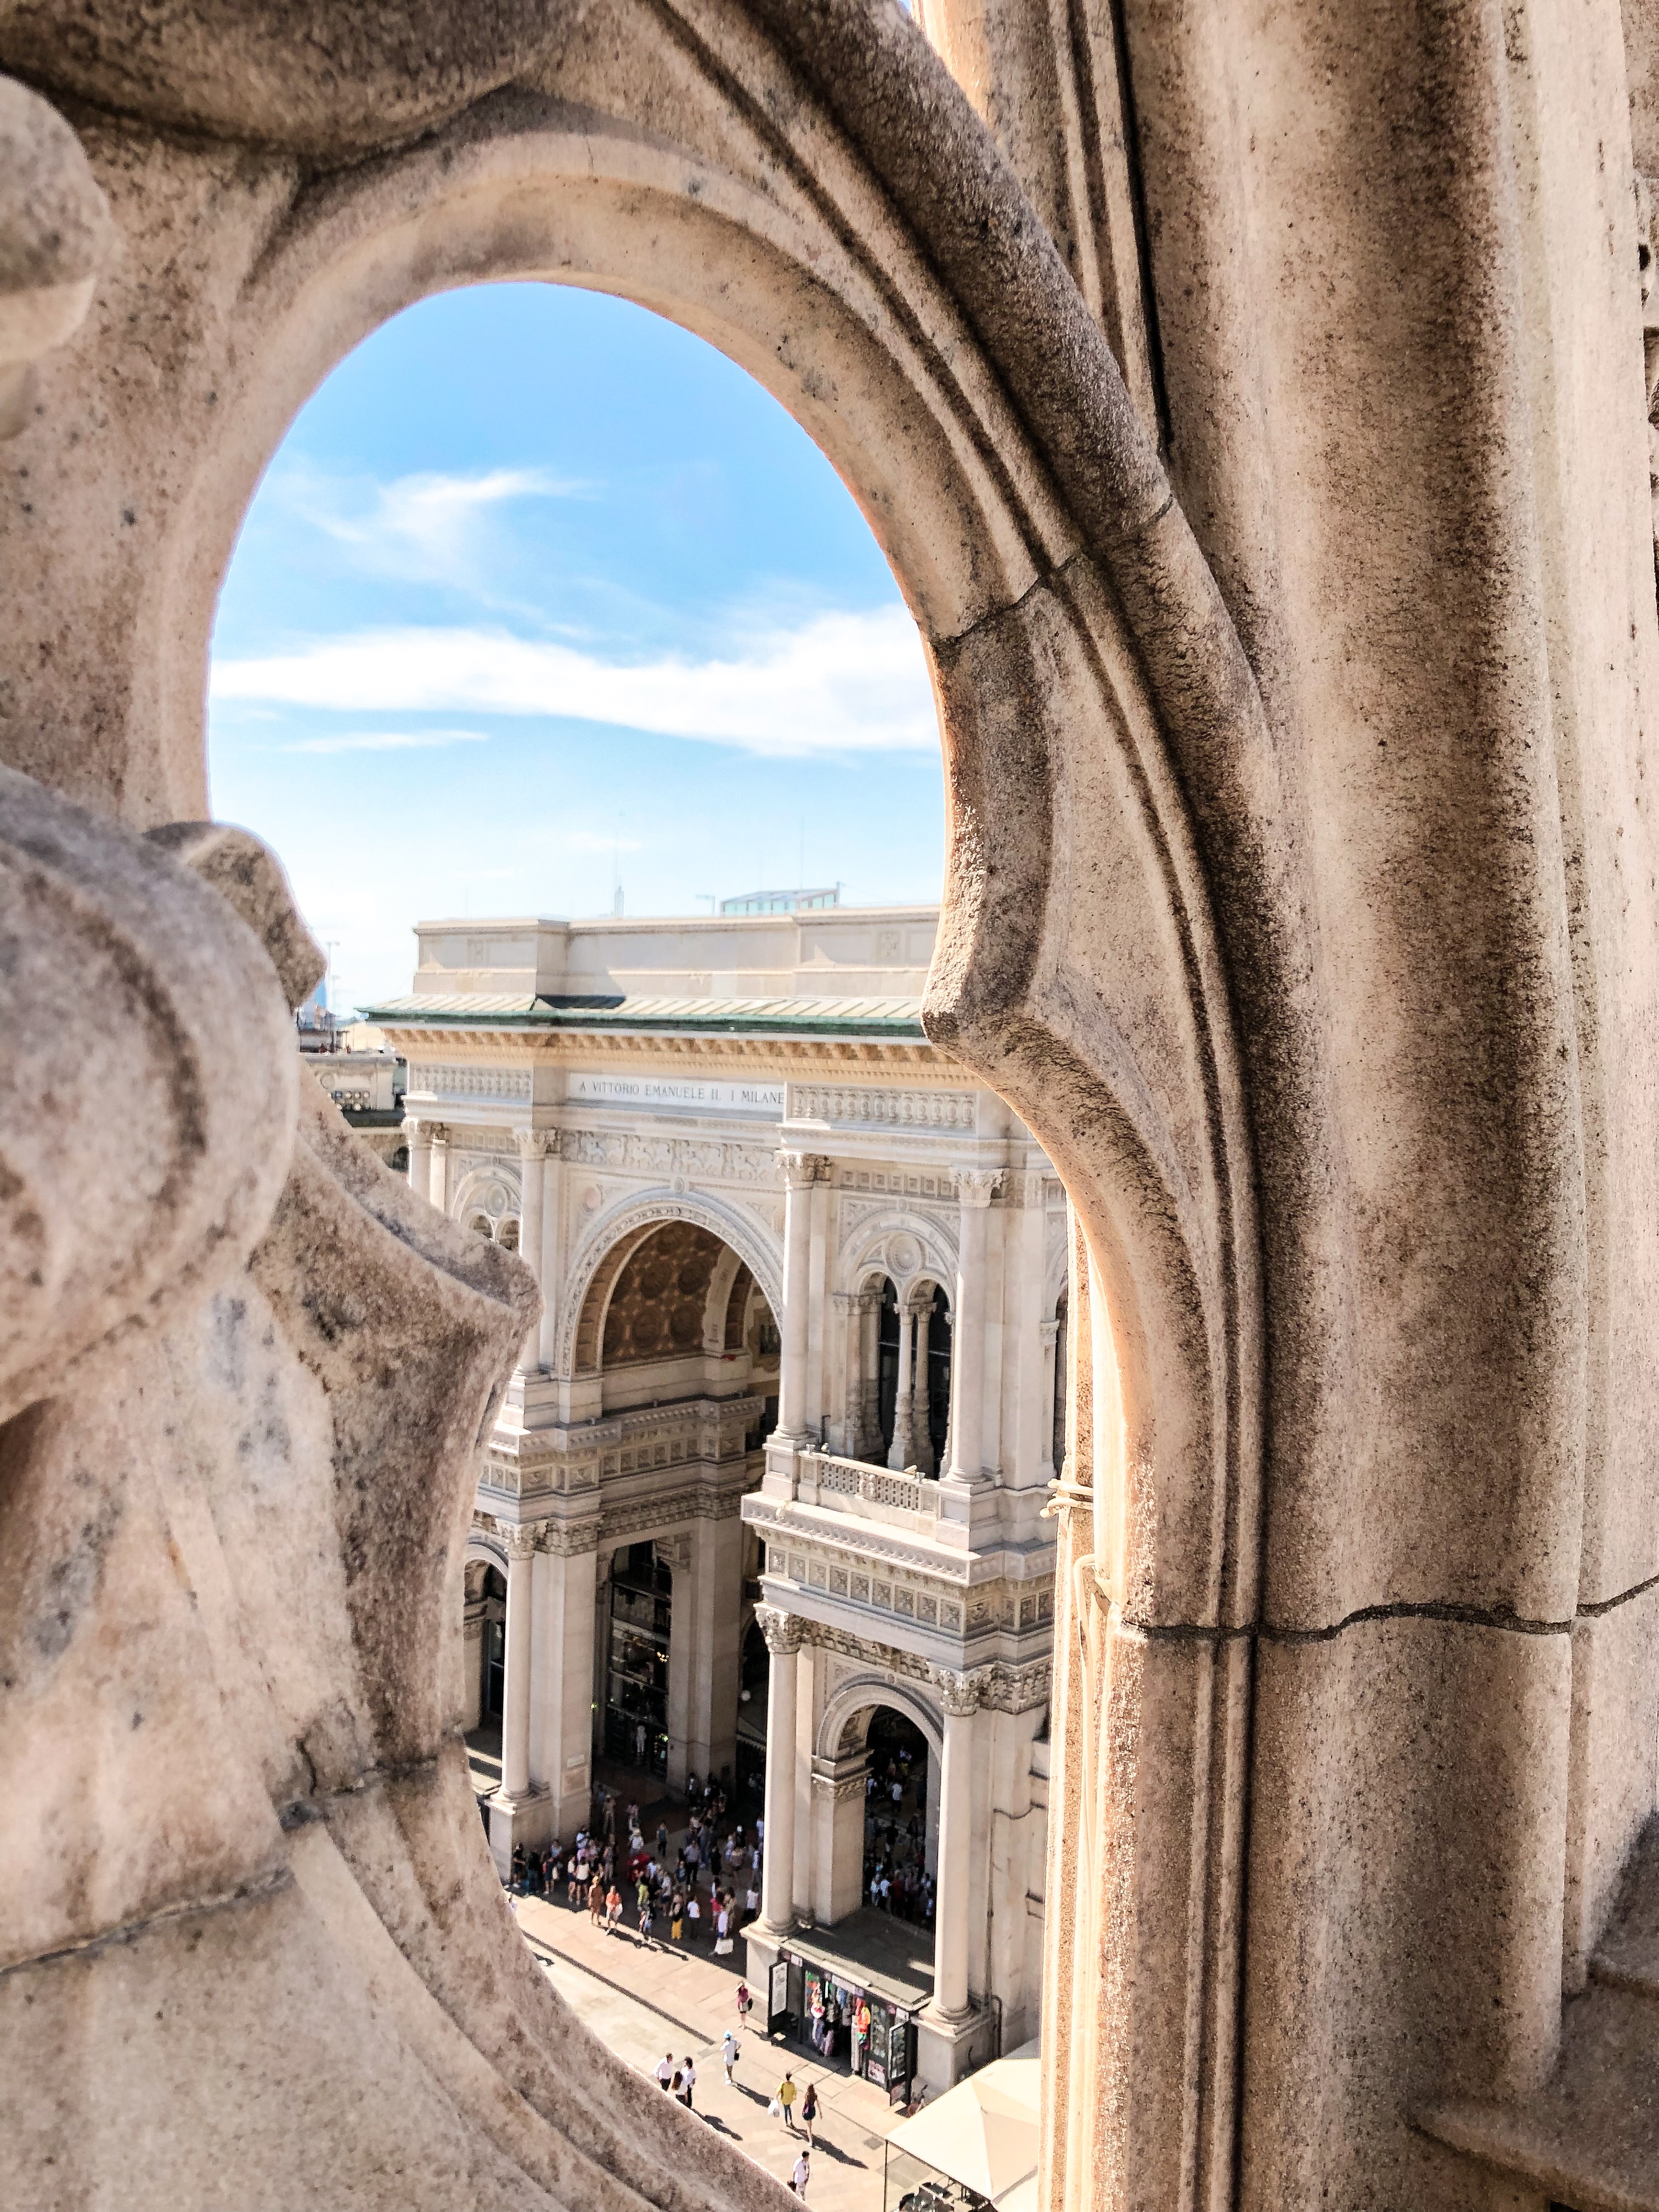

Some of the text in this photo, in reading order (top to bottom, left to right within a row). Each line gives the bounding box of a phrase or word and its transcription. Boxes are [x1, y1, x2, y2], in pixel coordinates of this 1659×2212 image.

[579, 1081, 586, 1092] A
[592, 1081, 640, 1095] VITTORIO
[645, 1084, 705, 1099] EMANUELE
[731, 1089, 735, 1101] I
